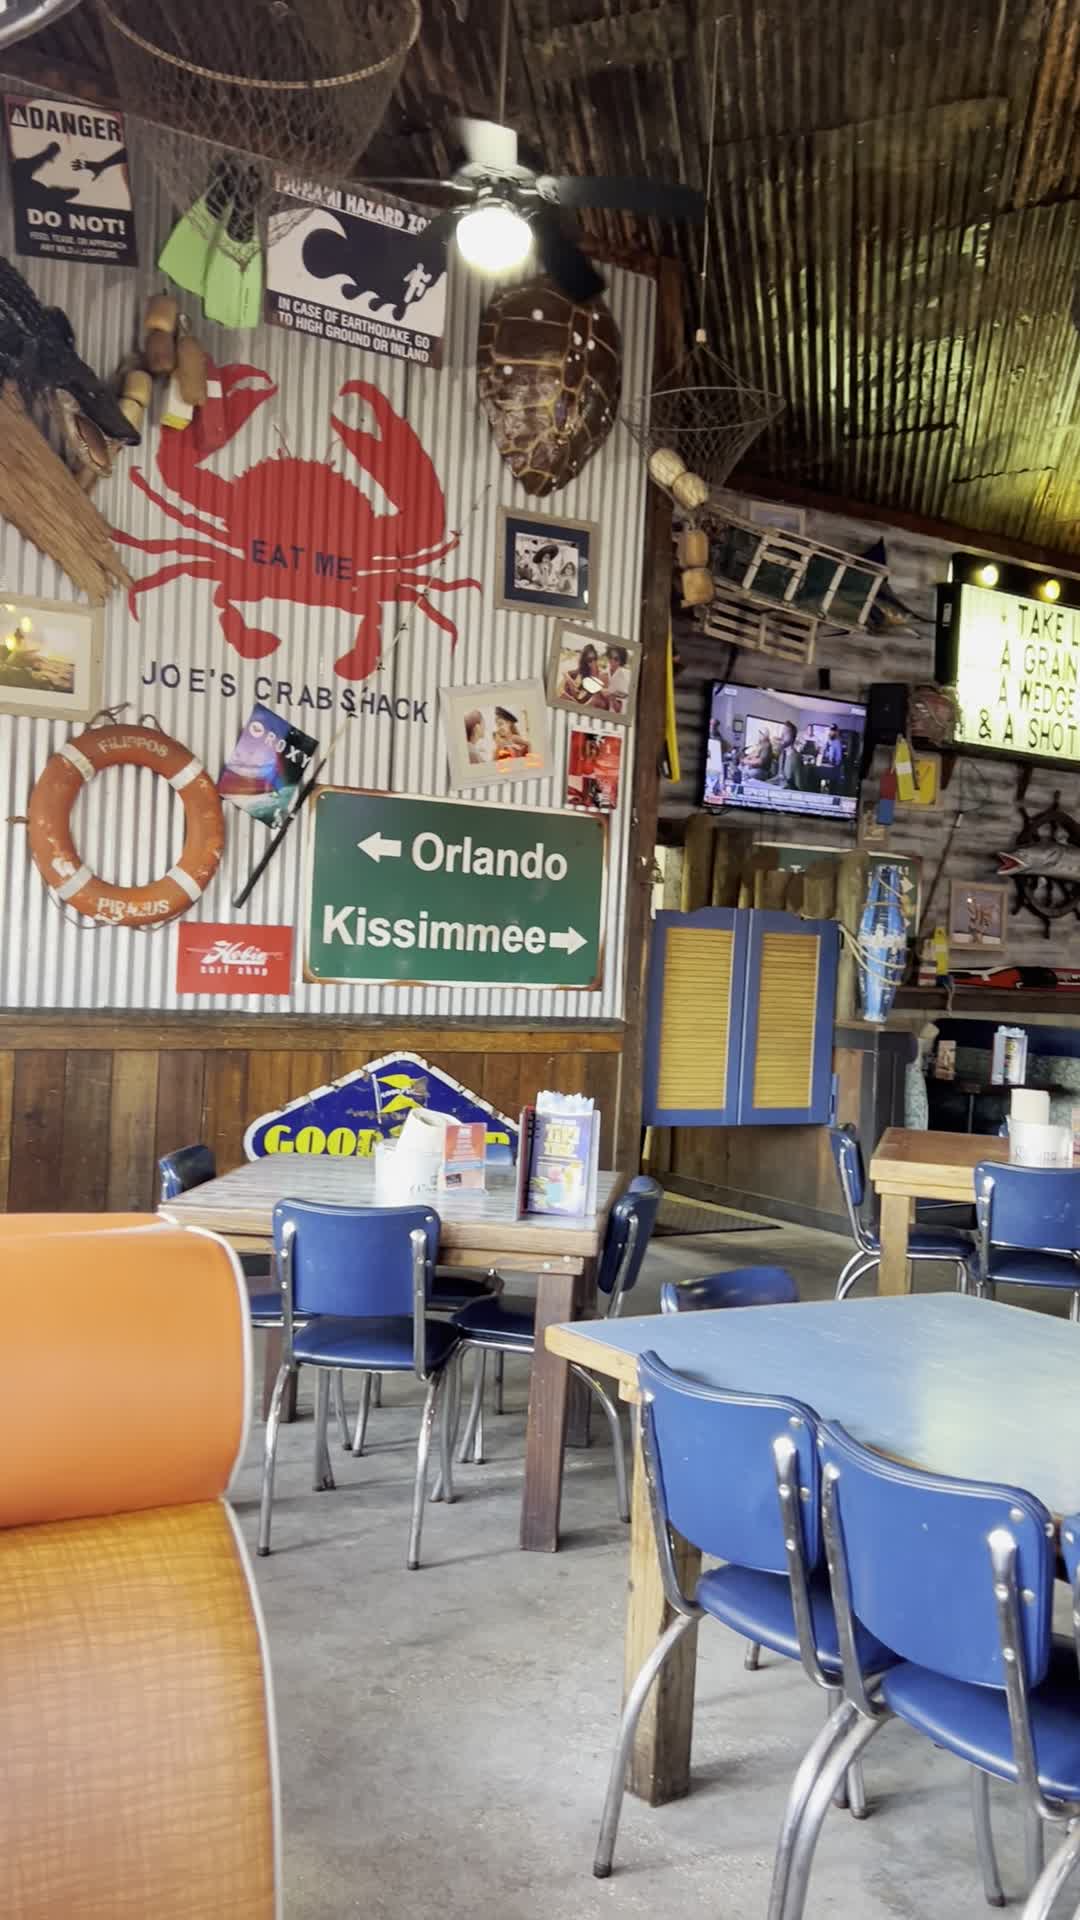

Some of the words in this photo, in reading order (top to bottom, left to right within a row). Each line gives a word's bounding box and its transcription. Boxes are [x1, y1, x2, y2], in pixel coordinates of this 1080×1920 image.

[29, 107, 121, 142] DANGER
[27, 208, 62, 228] DO
[69, 213, 126, 235] NOT!
[346, 194, 404, 228] HAZARD
[278, 296, 291, 310] IN
[293, 299, 322, 320] CASE
[324, 309, 338, 324] OF
[341, 313, 413, 345] EARTHQUAKE,
[415, 335, 430, 349] GO
[279, 311, 293, 326] TO
[296, 317, 323, 335] HIGH
[325, 323, 371, 348] GROUND
[373, 336, 388, 352] OR
[390, 341, 430, 363] INLAND
[252, 540, 304, 570] EAT
[315, 551, 353, 580] ME
[1018, 604, 1064, 644] TAKE
[1000, 639, 1011, 668] A
[1024, 644, 1080, 684] GRAIN
[142, 661, 236, 697] JOE'S
[254, 676, 333, 711] CRAB
[340, 687, 428, 723] SHACK
[998, 676, 1008, 704] A
[1018, 679, 1076, 719] WEDGE
[264, 731, 312, 769] ROXY
[978, 709, 992, 740] &
[1002, 713, 1013, 744] A
[1028, 718, 1078, 754] SHOT
[411, 832, 568, 881] Orlando
[322, 905, 547, 954] Kissimmee
